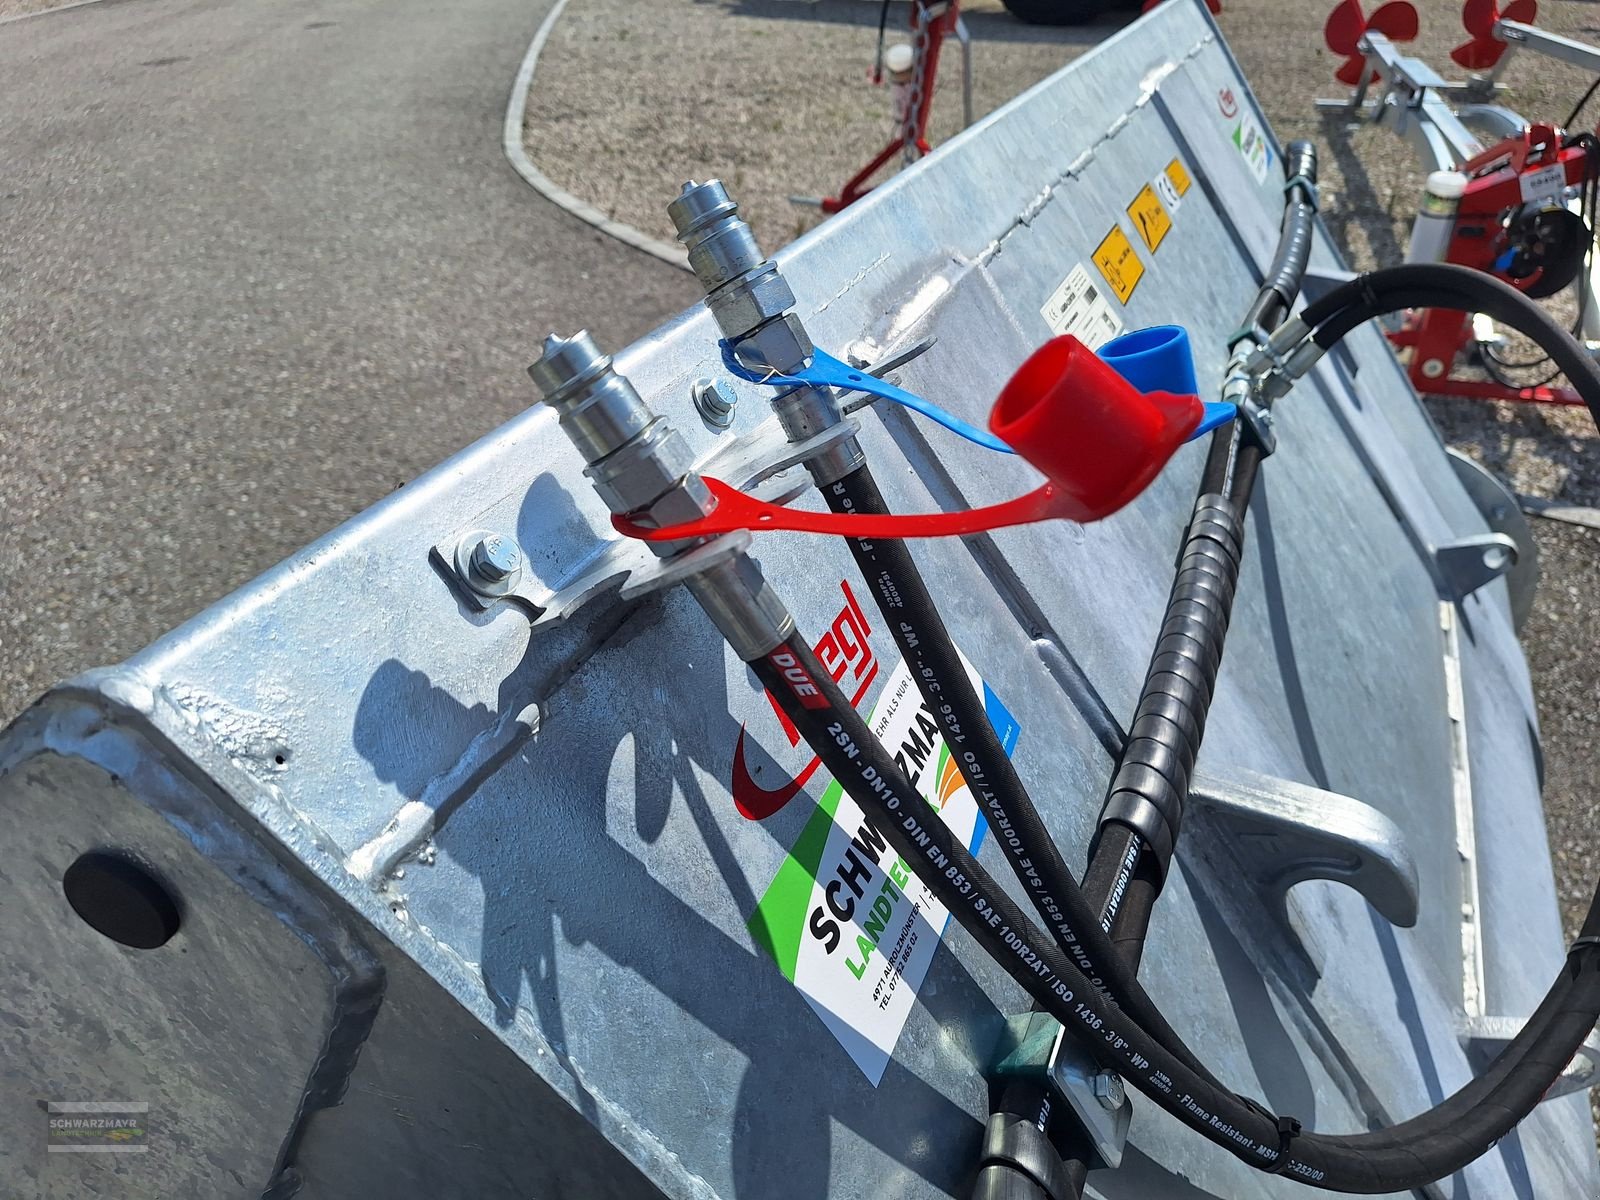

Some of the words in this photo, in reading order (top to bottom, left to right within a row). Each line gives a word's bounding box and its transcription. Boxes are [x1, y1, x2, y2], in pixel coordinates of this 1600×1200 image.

[900, 622, 919, 649] WP
[772, 653, 818, 697] DUE
[874, 716, 890, 740] EHR
[889, 698, 899, 719] ALS
[895, 679, 909, 701] NUR
[940, 703, 966, 743] 1436
[963, 751, 985, 779] ISO
[981, 790, 1025, 856] 100R2AT
[1125, 846, 1138, 870] SAE
[1019, 858, 1042, 887] SAE
[827, 722, 860, 760] 2SN
[861, 766, 900, 810] DN10
[902, 816, 931, 847] DIN
[926, 845, 949, 869] EN
[945, 866, 972, 894] 853
[974, 898, 1001, 928] SAE
[999, 926, 1050, 977] 100R2AT
[1051, 979, 1074, 1002] ISO
[1075, 1003, 1103, 1029] 1436
[1130, 1053, 1149, 1070] WP
[1041, 896, 1063, 921] 853
[910, 932, 918, 945] 02
[1058, 923, 1077, 943] EN
[1101, 918, 1111, 934] IS
[872, 978, 886, 1002] 4971
[1180, 1094, 1210, 1121] Flame
[1209, 1116, 1253, 1149] Resistant
[1256, 1144, 1279, 1161] MSH
